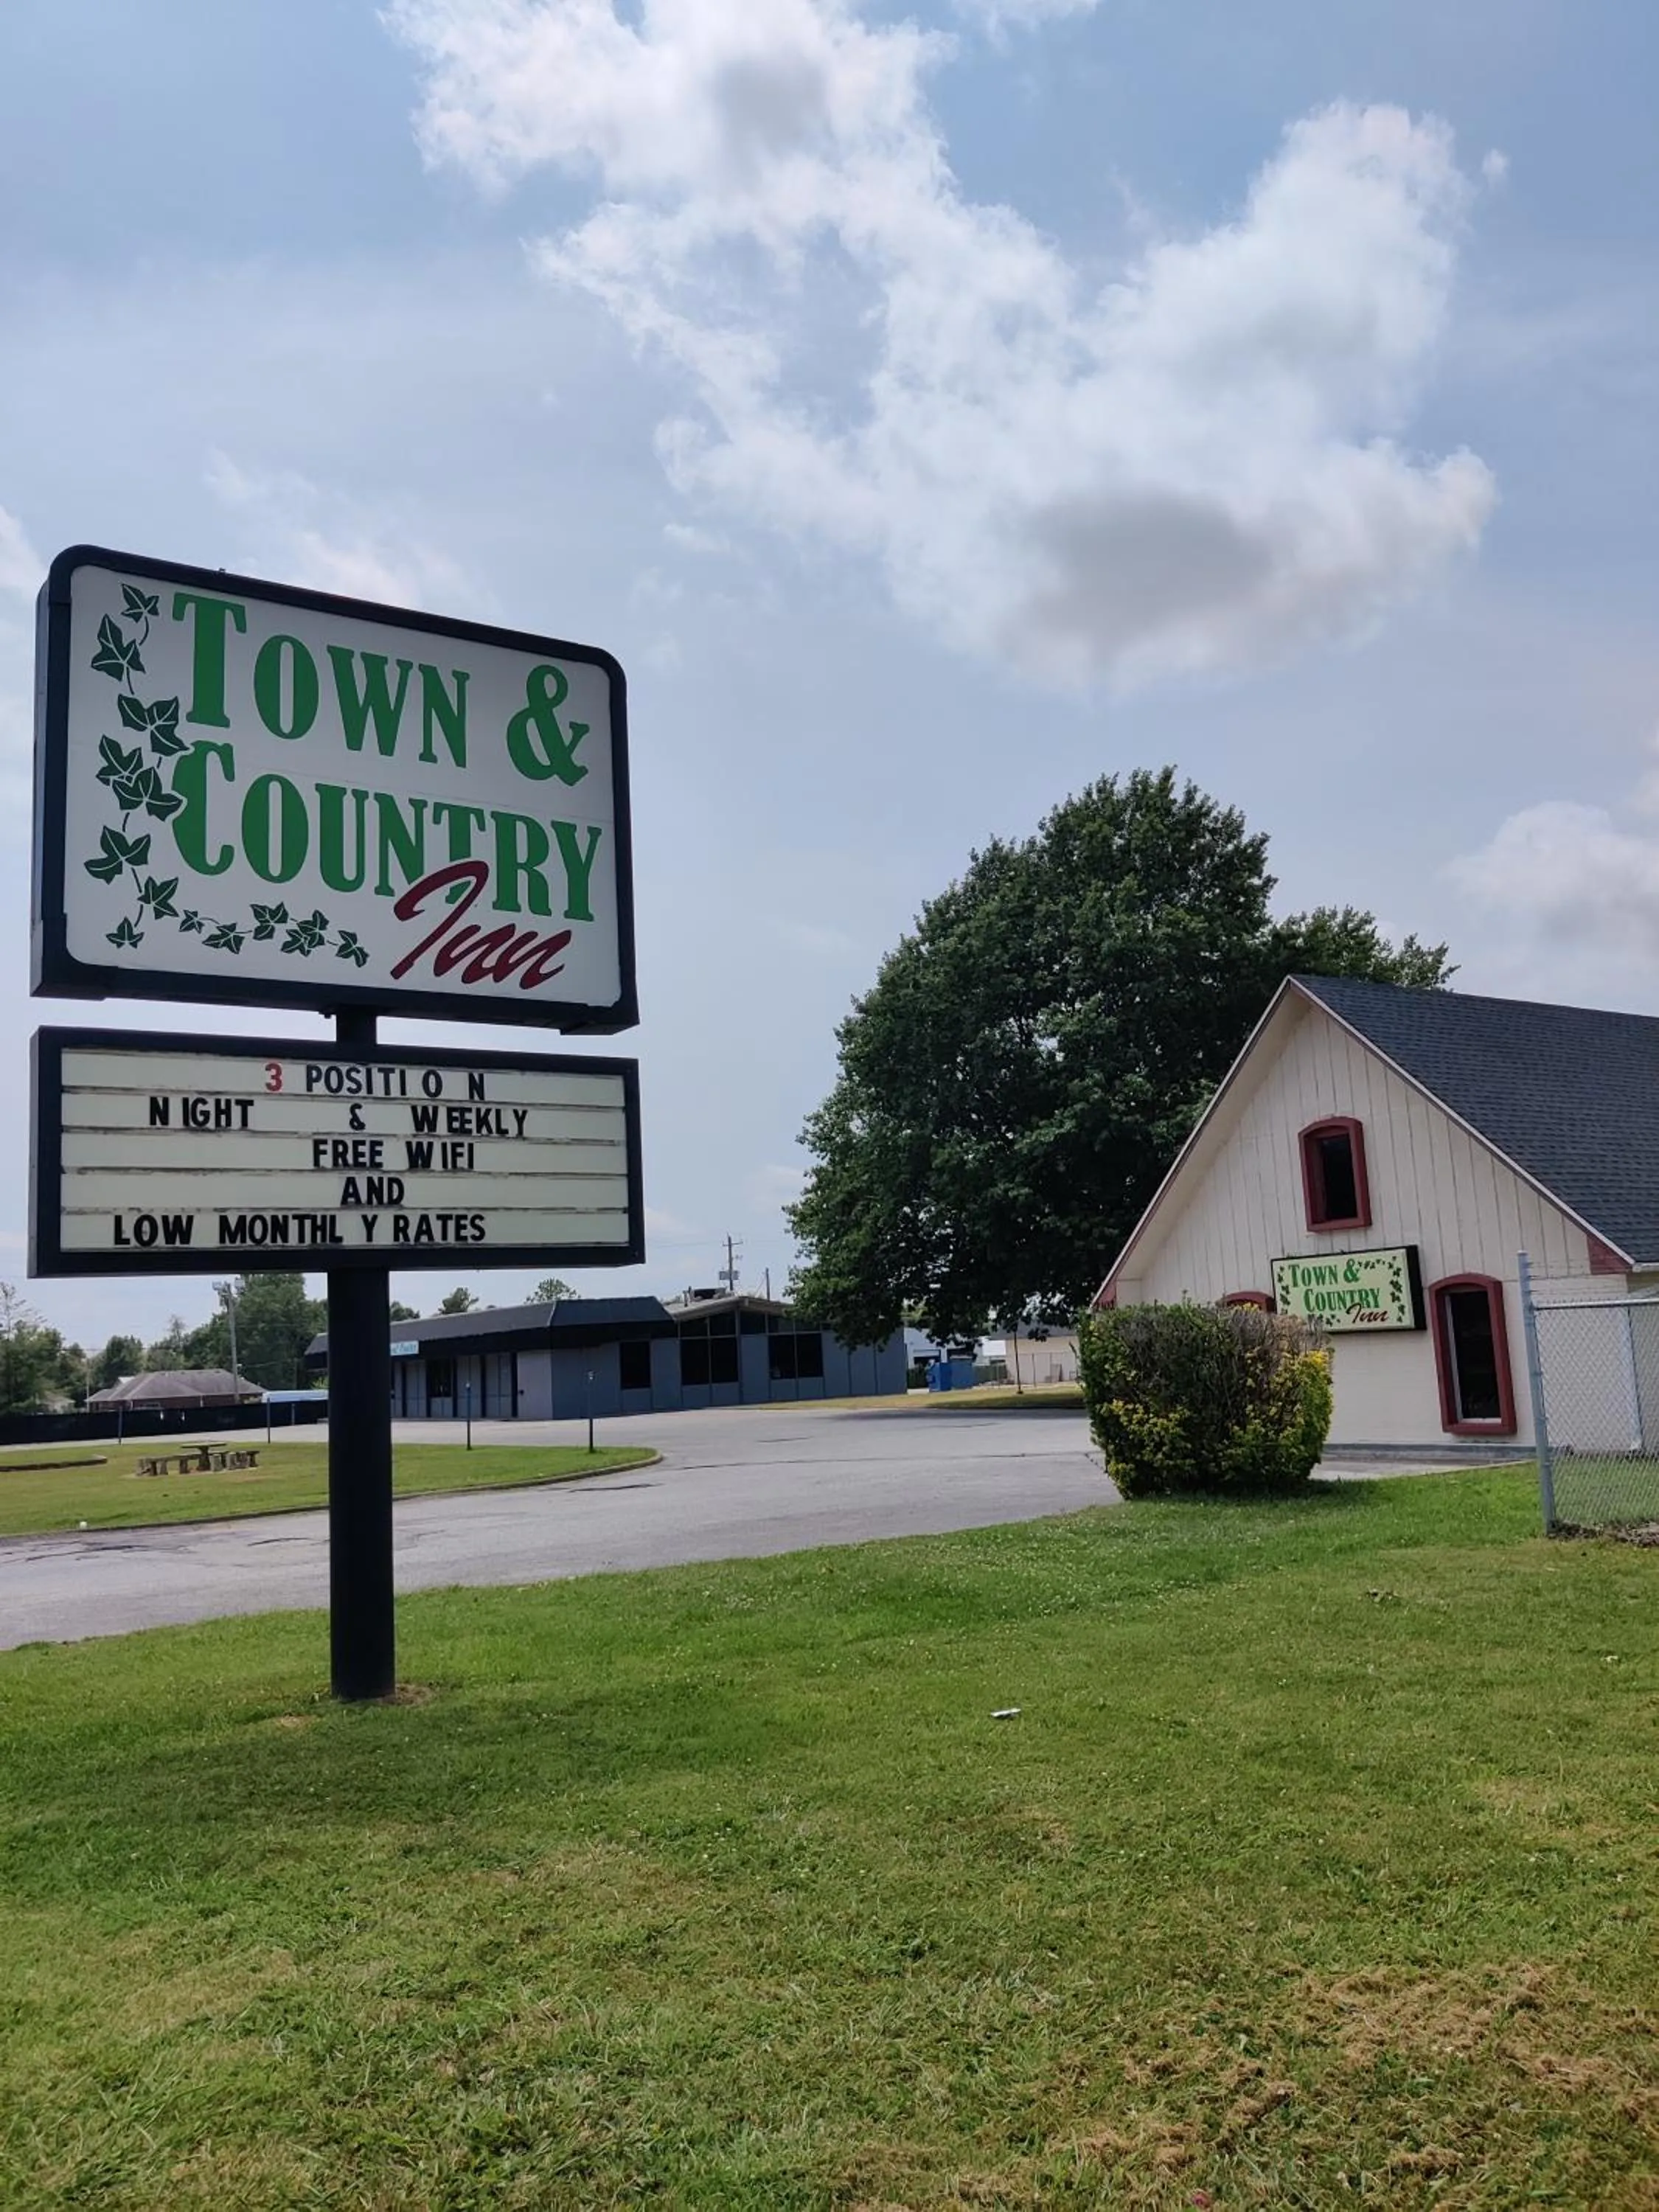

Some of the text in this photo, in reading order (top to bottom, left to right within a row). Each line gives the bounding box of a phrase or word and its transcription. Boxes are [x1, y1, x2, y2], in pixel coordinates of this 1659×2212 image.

[172, 592, 590, 786] TOWN &
[171, 740, 601, 922] COUNTRY
[389, 860, 572, 990] Inn
[265, 1062, 283, 1092] 3
[150, 1096, 528, 1136] NIGHT & WEEKLY
[313, 1138, 474, 1170] FREE WIFI
[341, 1176, 405, 1206] AND
[114, 1214, 194, 1246] LOW
[393, 1214, 486, 1242] RATES
[1288, 1258, 1360, 1288] TOWN &
[1303, 1287, 1381, 1312] COUNTRY
[1345, 1302, 1389, 1324] Inn
